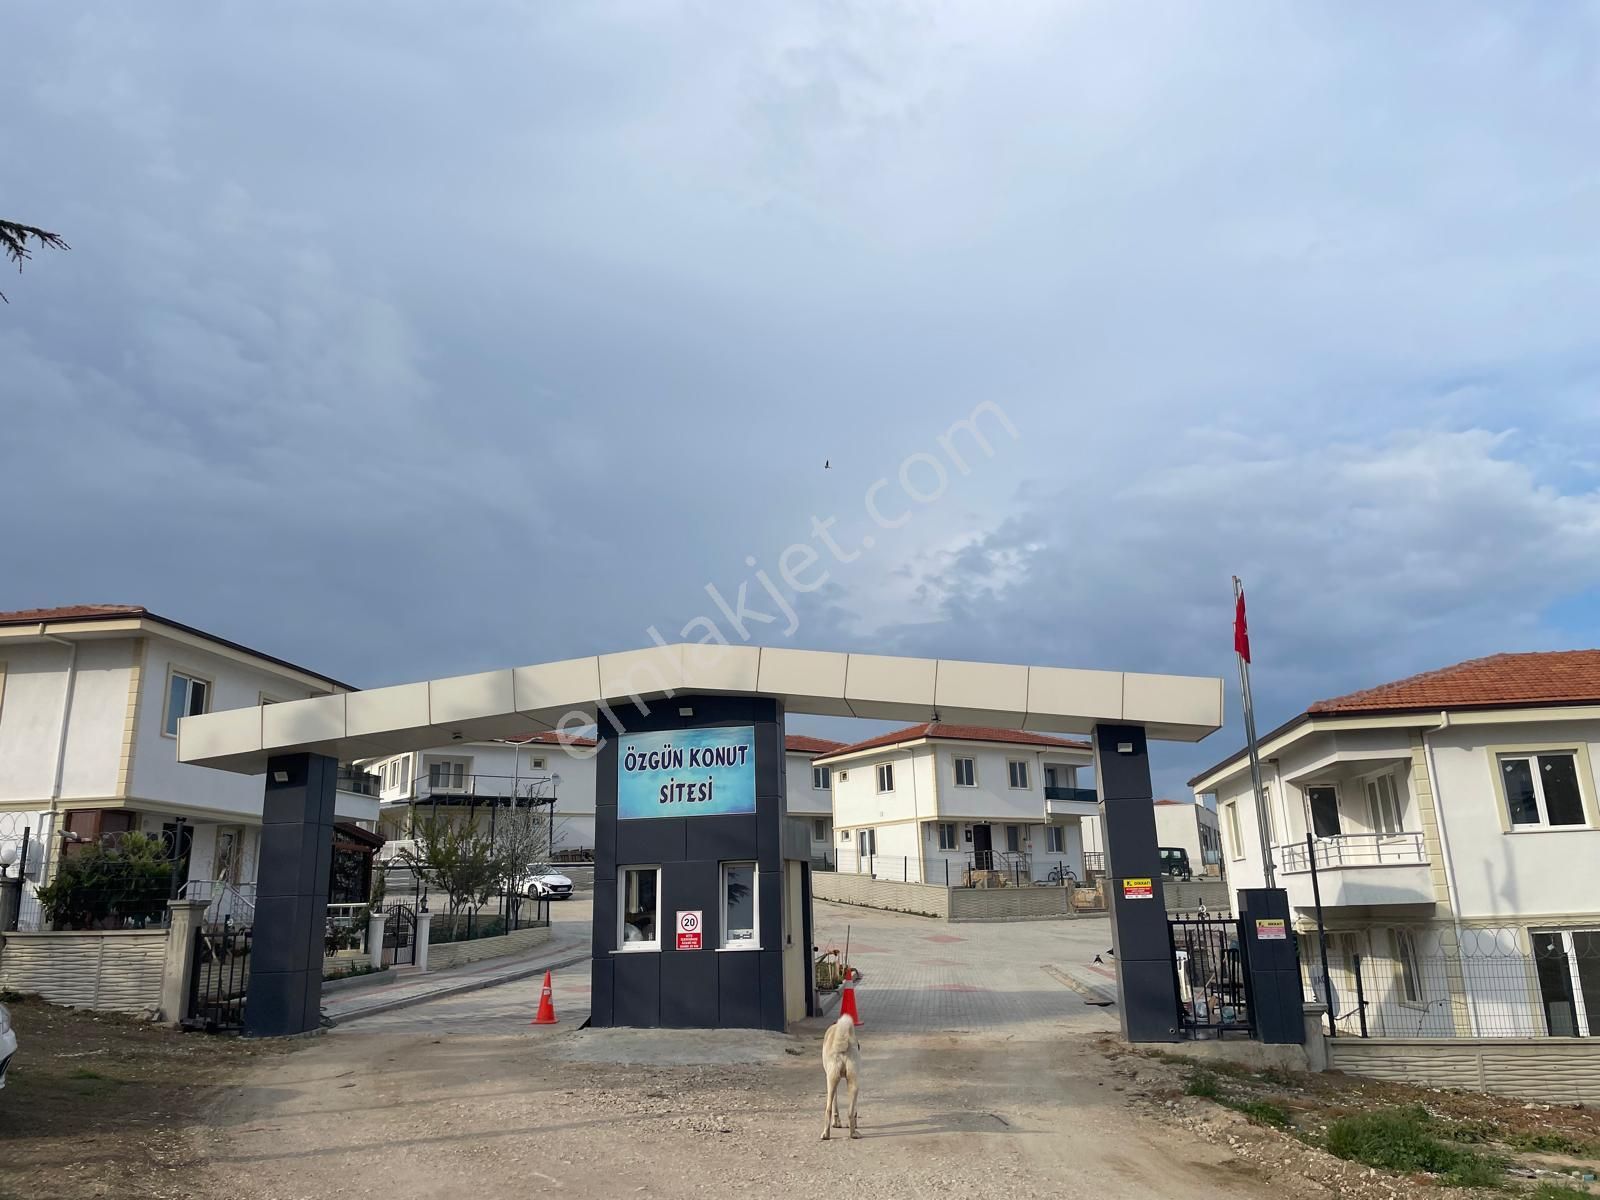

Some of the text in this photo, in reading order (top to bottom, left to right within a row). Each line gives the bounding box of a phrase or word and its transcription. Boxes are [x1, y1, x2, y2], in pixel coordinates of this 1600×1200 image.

[624, 743, 749, 772] ÖZGÜN KONUT
[659, 775, 713, 804] SİTESİ
[684, 918, 695, 927] 20
